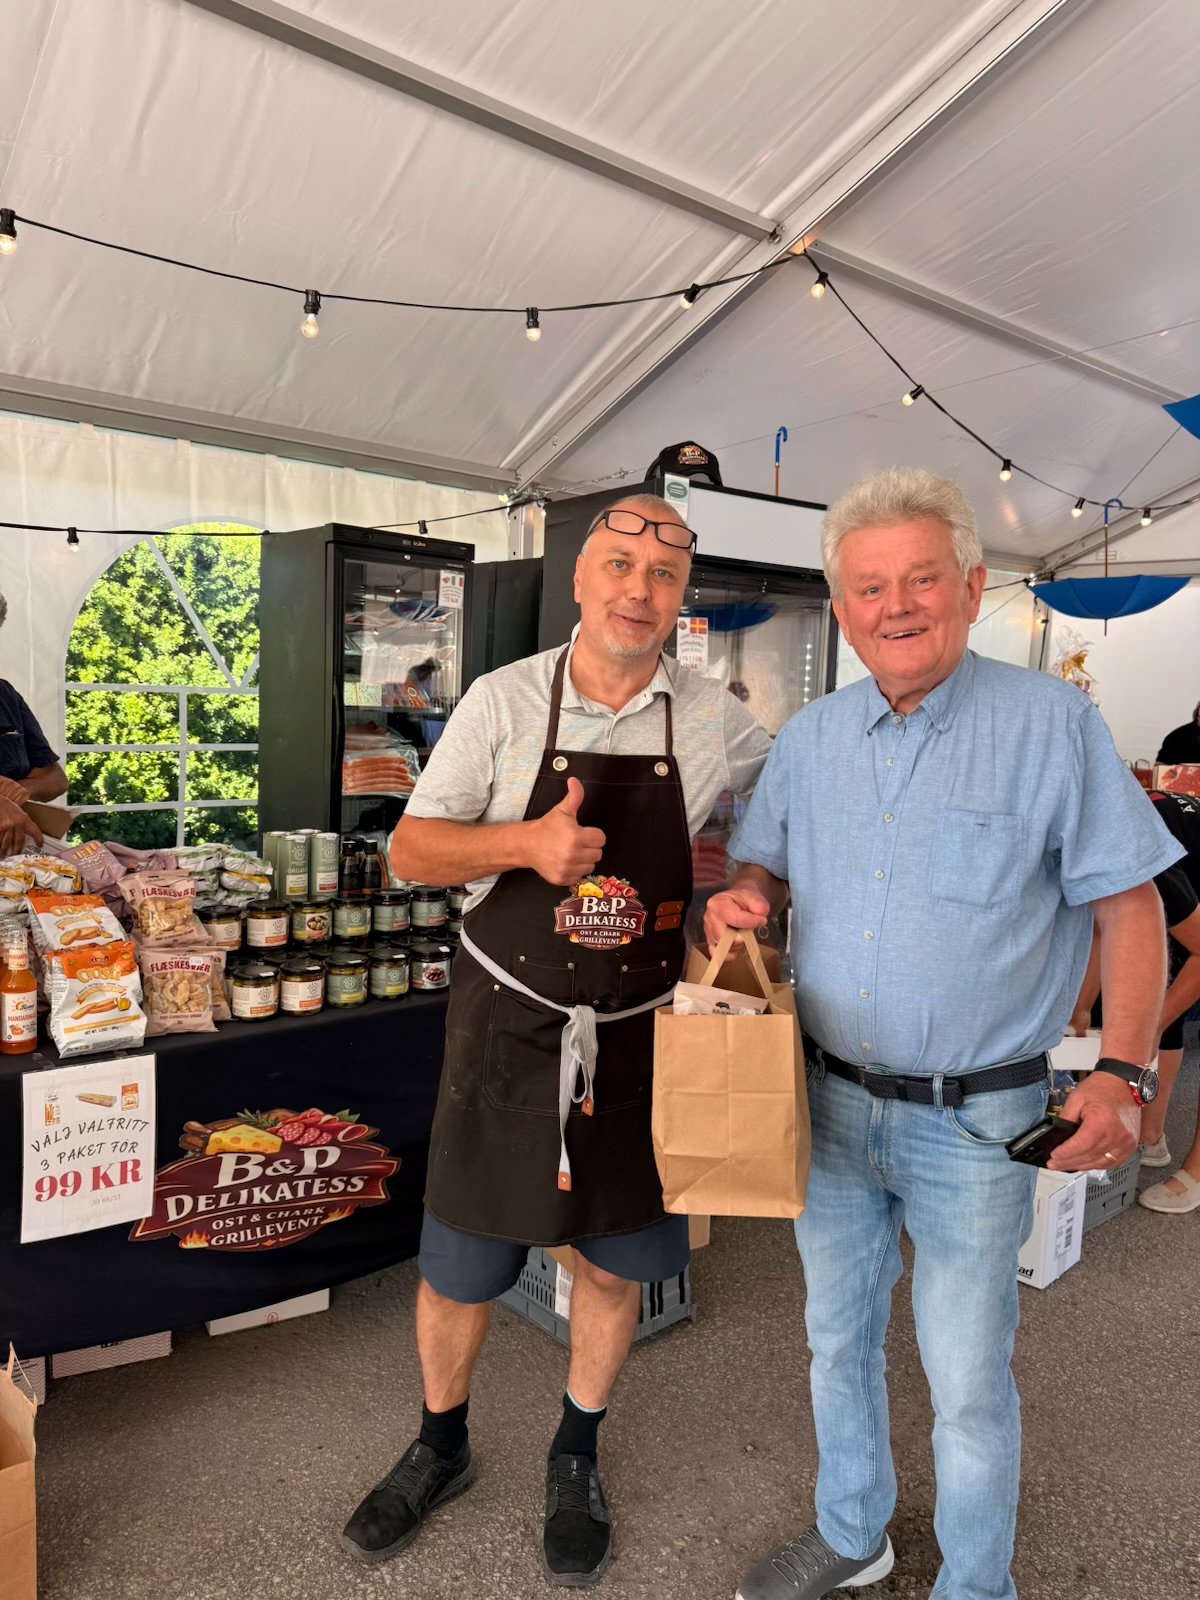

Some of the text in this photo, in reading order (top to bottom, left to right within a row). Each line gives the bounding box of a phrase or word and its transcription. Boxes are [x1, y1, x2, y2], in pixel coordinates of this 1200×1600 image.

[565, 914, 638, 929] DELIKATESS
[581, 896, 626, 915] B&P
[579, 936, 621, 945] GRILLEVENT
[31, 1117, 150, 1153] VÄLJ VALFRITT
[40, 1138, 139, 1171] 3 PAKET FÖR
[213, 1145, 342, 1189] B&P
[34, 1158, 143, 1203] 99 KR
[164, 1175, 369, 1223] DELIKATESS
[210, 1215, 323, 1247] GRILLEVENT
[211, 1205, 326, 1231] OST & CHARK
[1017, 1265, 1034, 1278] ad
